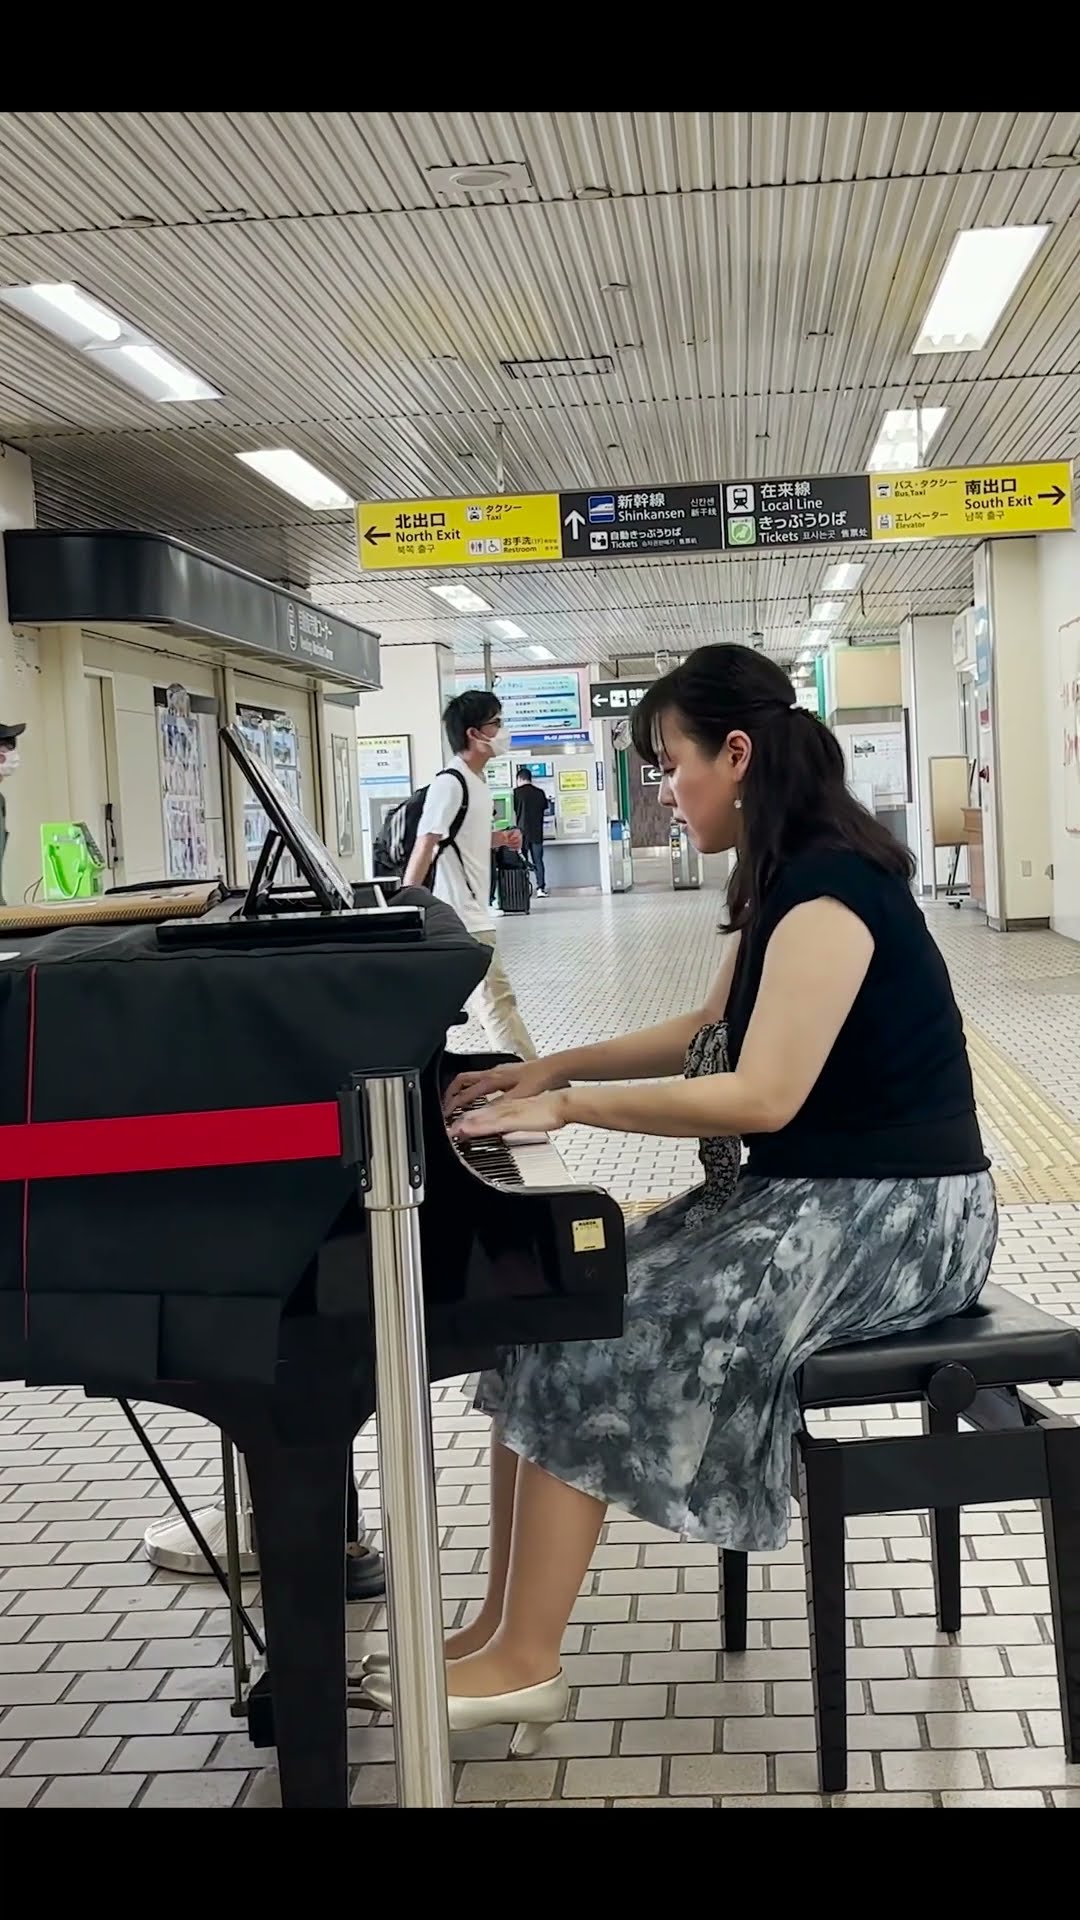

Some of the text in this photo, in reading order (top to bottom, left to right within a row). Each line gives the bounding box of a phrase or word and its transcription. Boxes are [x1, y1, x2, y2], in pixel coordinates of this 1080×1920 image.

[760, 481, 811, 499] 在来線
[965, 478, 1017, 496] 南出口
[617, 492, 665, 509] 新幹線
[761, 498, 823, 512] Local Line
[965, 494, 1033, 510] South Exit
[486, 504, 522, 513] タクシー
[618, 508, 685, 522] Shinkansen
[395, 513, 445, 529] 北出口
[759, 511, 848, 530] きっぷうりば
[895, 511, 949, 522] エレベーター
[396, 529, 460, 543] North Exit
[610, 527, 682, 541] 自動きっぷうりば
[759, 531, 799, 543] Tickets
[418, 544, 435, 553] 출구
[611, 541, 638, 549] Tickets
